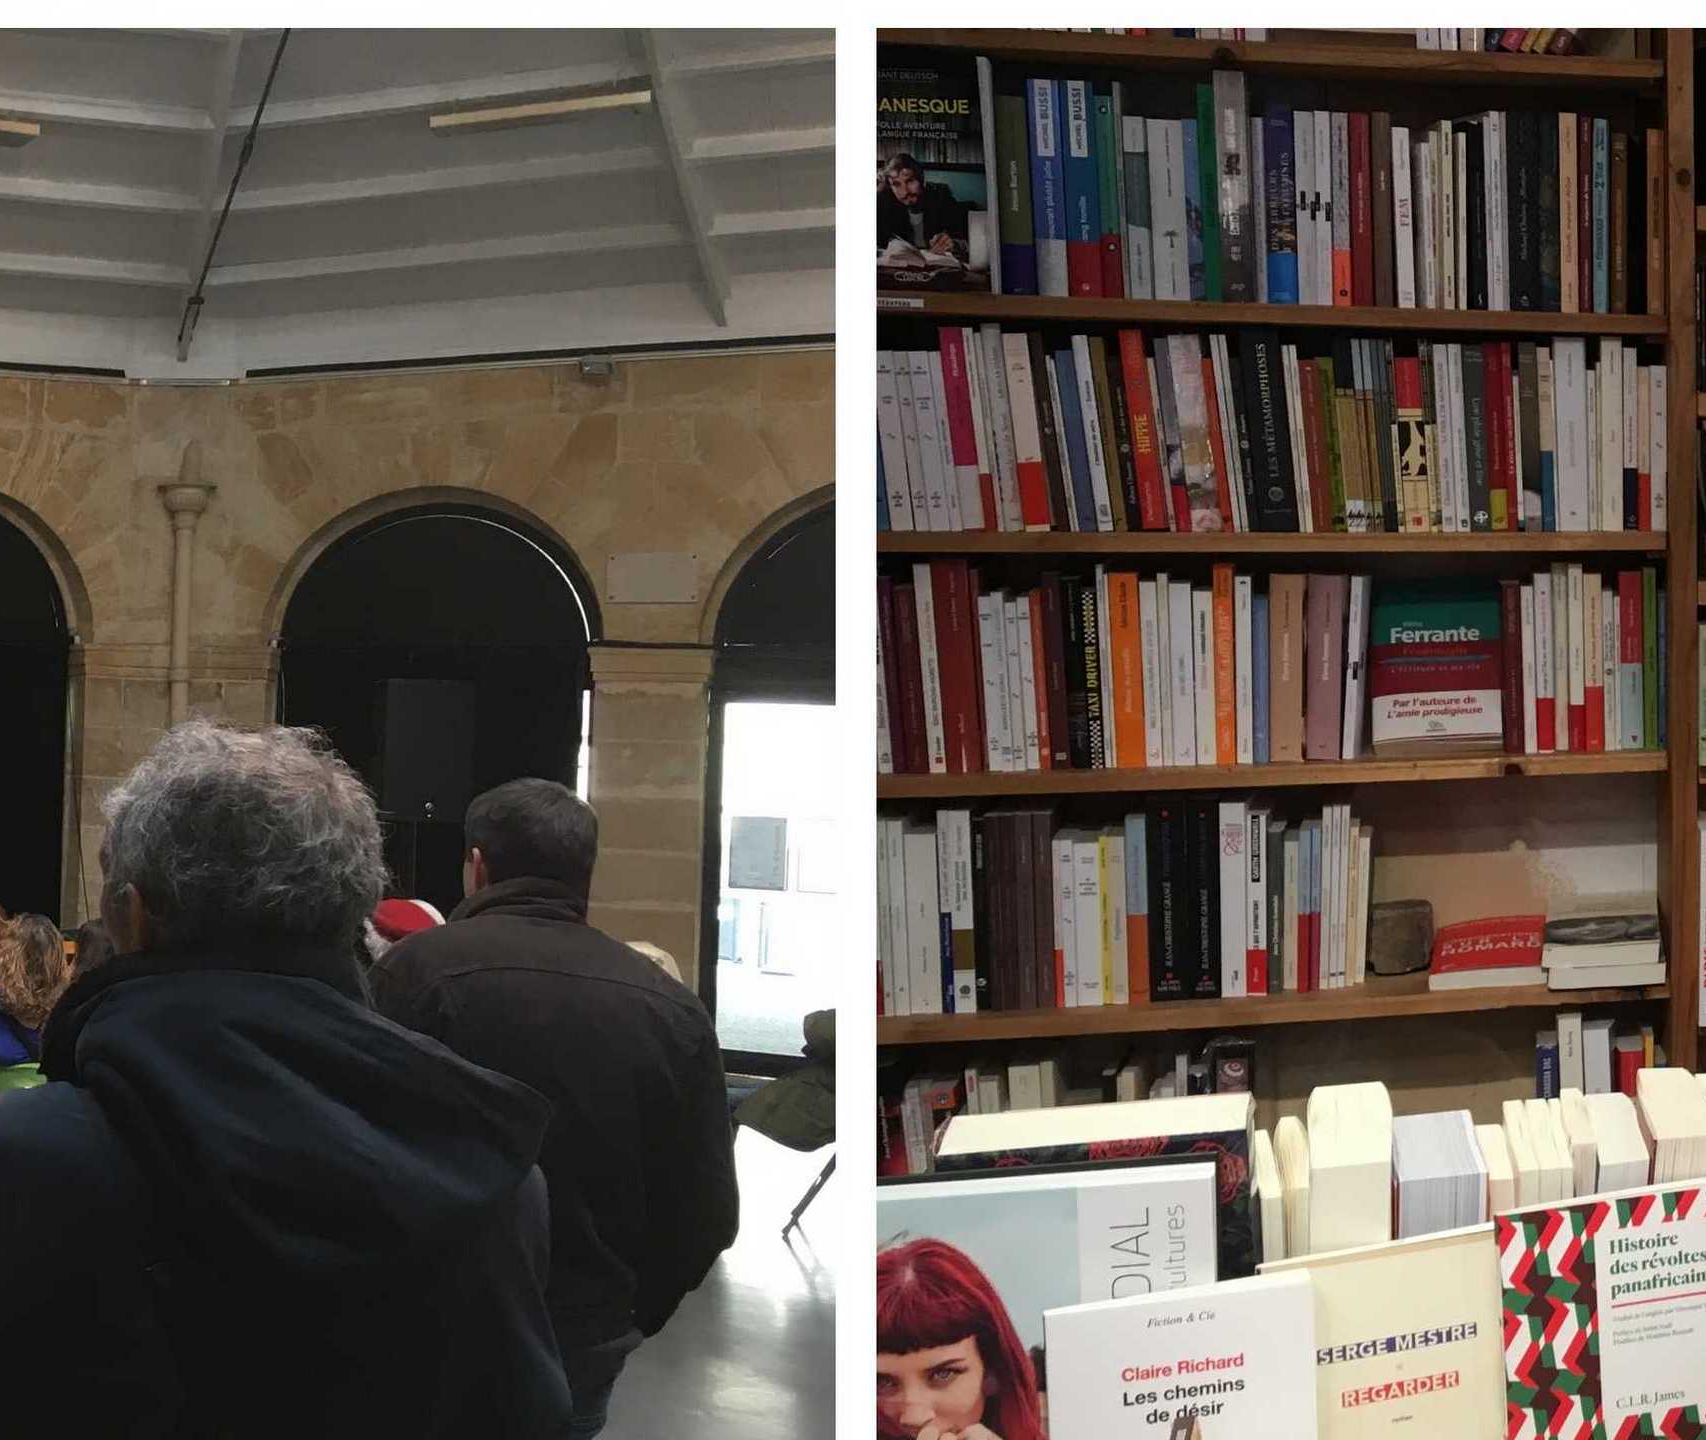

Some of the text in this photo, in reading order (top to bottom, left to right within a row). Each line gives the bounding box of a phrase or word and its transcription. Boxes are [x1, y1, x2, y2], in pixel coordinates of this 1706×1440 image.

[1038, 86, 1050, 120] BUSSI
[1071, 88, 1082, 120] BUSSI
[903, 122, 946, 130] AVENTURE
[1255, 343, 1278, 453] MÉTAMORPHOSES
[1134, 413, 1151, 454] HIPPIE
[1390, 626, 1480, 644] Ferrante
[1086, 647, 1100, 717] TAXI DRIVER
[1393, 699, 1411, 708] Par
[1422, 708, 1483, 717] prodigieuse
[1608, 1232, 1679, 1255] Histoire
[1610, 1257, 1638, 1276] des
[1317, 1322, 1477, 1366] SERGE MESTRE
[1121, 1353, 1245, 1383] Claire Richard
[1123, 1377, 1246, 1408] Les chemins
[1341, 1371, 1460, 1408] REGARDER
[1652, 1389, 1686, 1405] James
[1145, 1406, 1171, 1425] de
